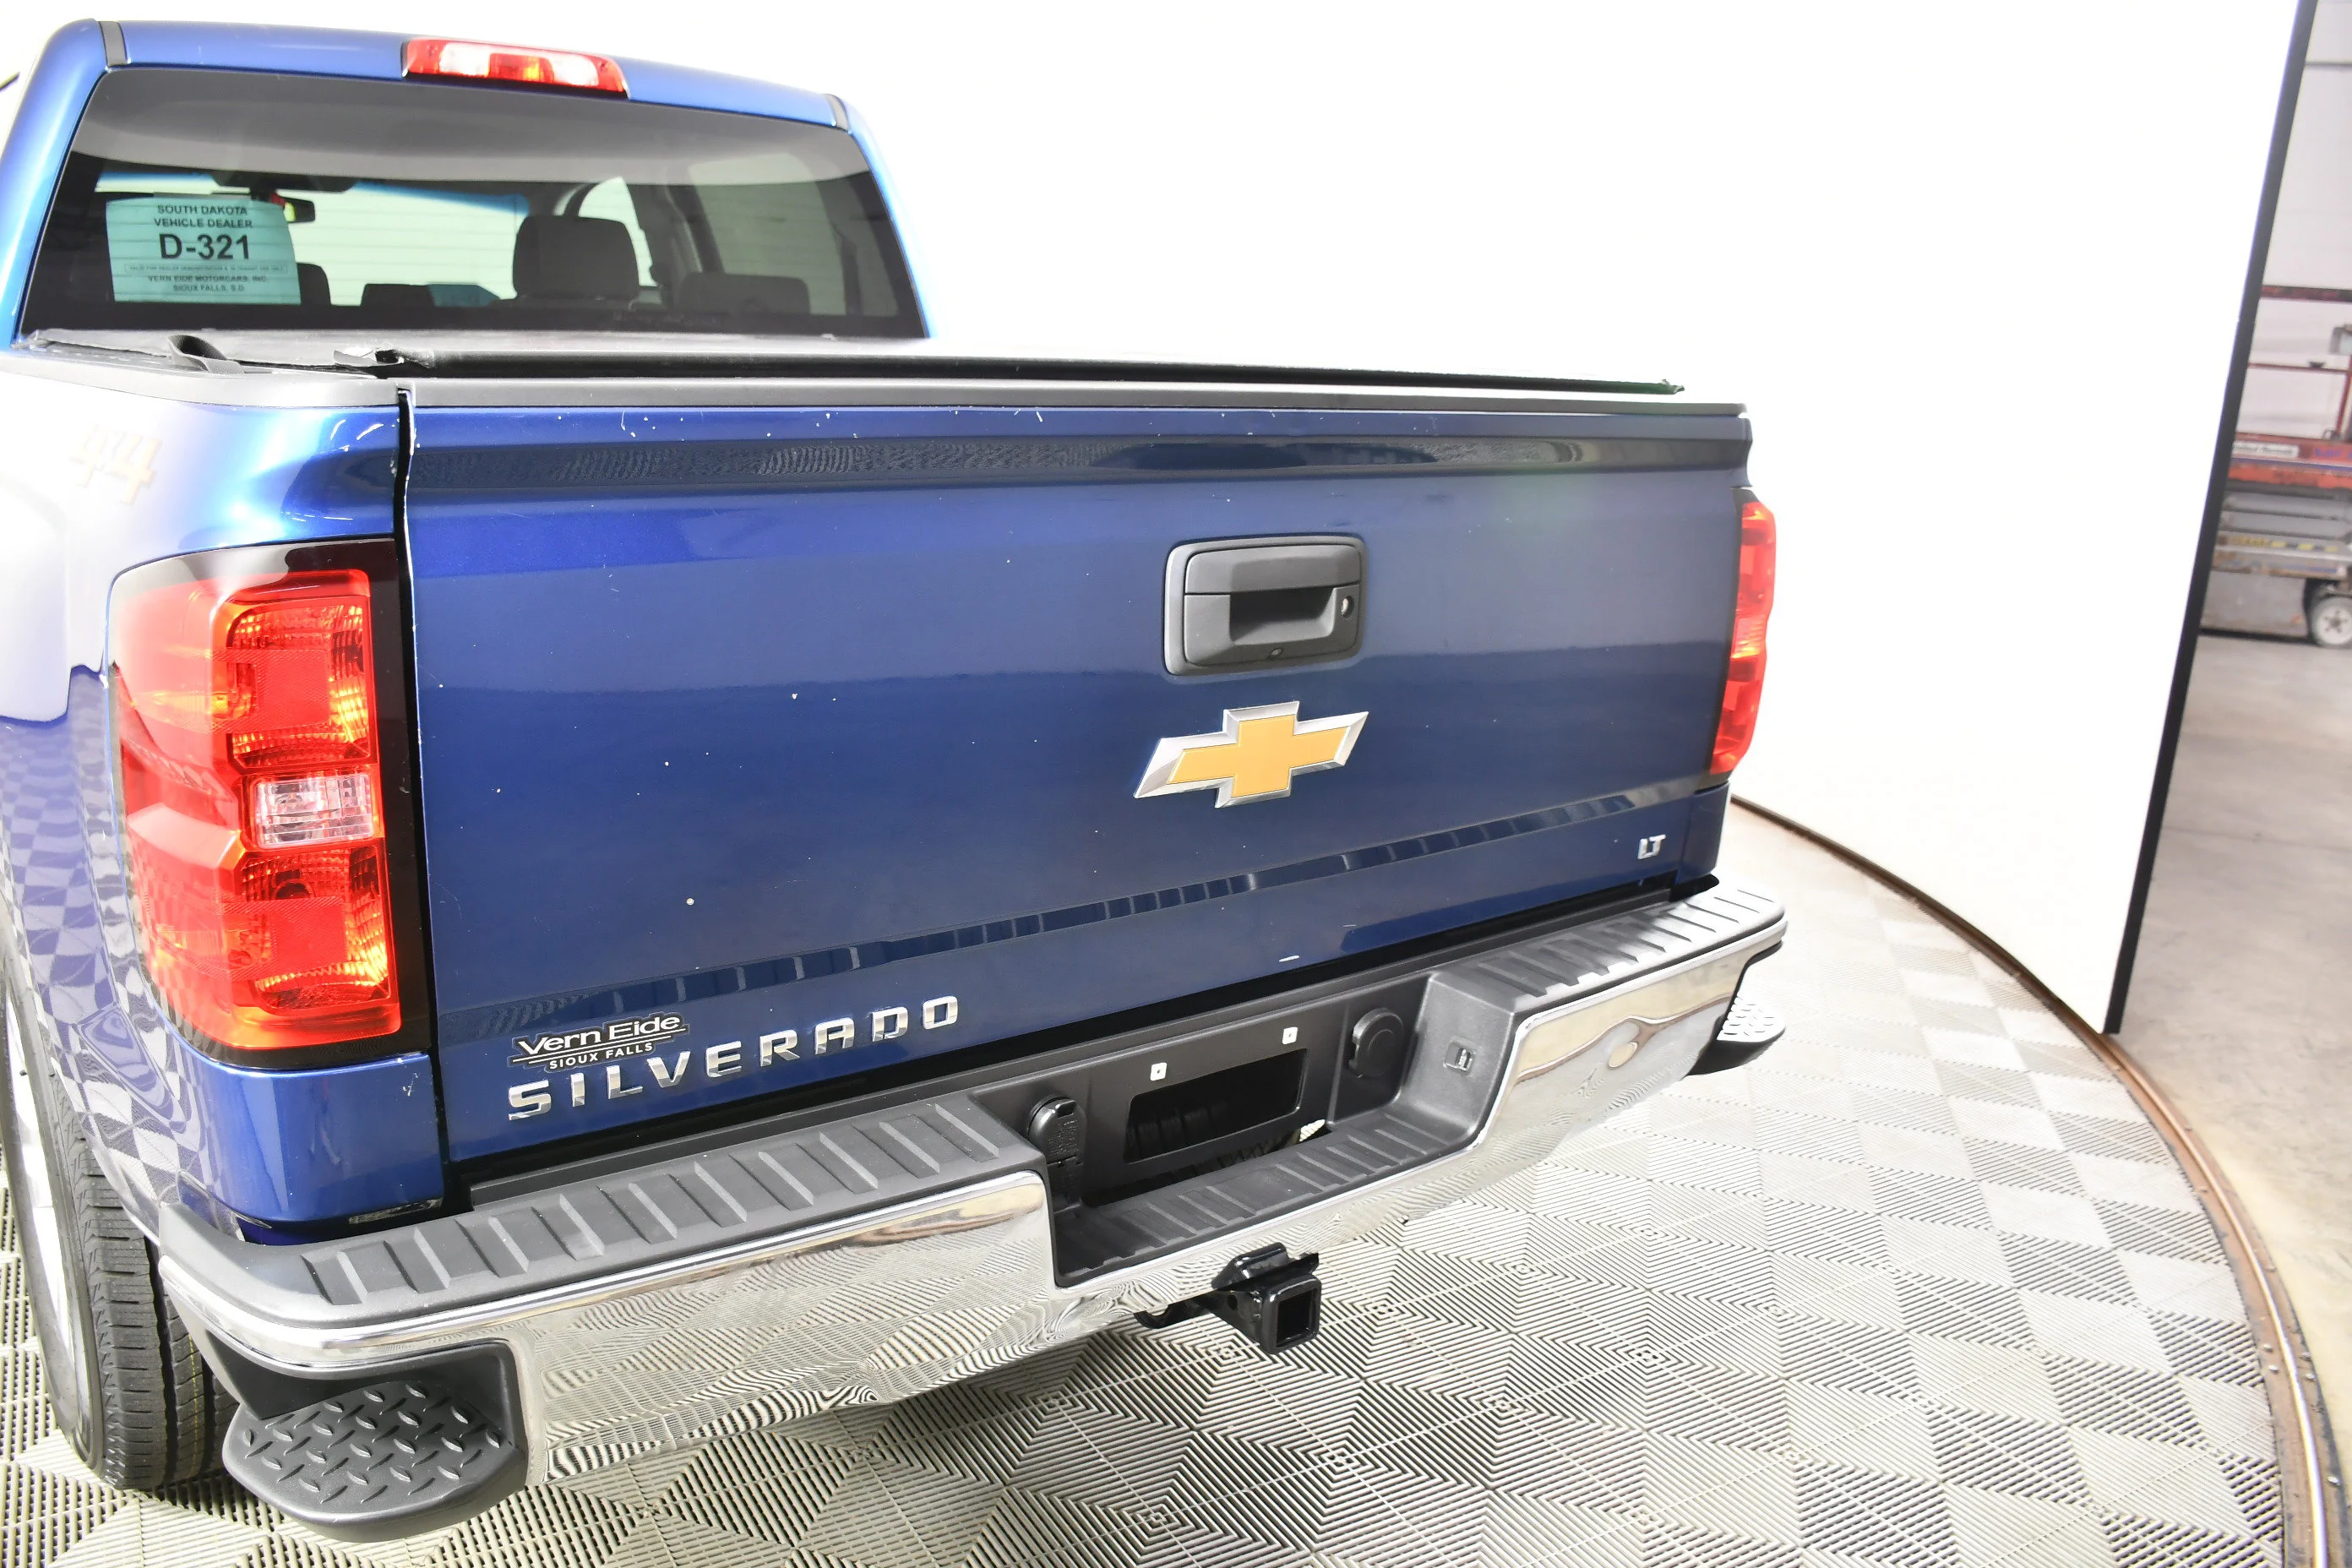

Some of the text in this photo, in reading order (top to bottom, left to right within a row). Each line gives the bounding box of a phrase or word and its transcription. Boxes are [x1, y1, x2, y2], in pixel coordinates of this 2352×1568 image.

[154, 217, 253, 229] VEHICLE DEALER
[157, 204, 248, 215] SOUTH DAKOTA
[159, 232, 250, 260] D-321
[1637, 834, 1667, 860] LT
[518, 1015, 681, 1056] Vern Eide
[508, 995, 959, 1121] SILVERADO
[549, 1042, 653, 1070] SIOUX FALLS
